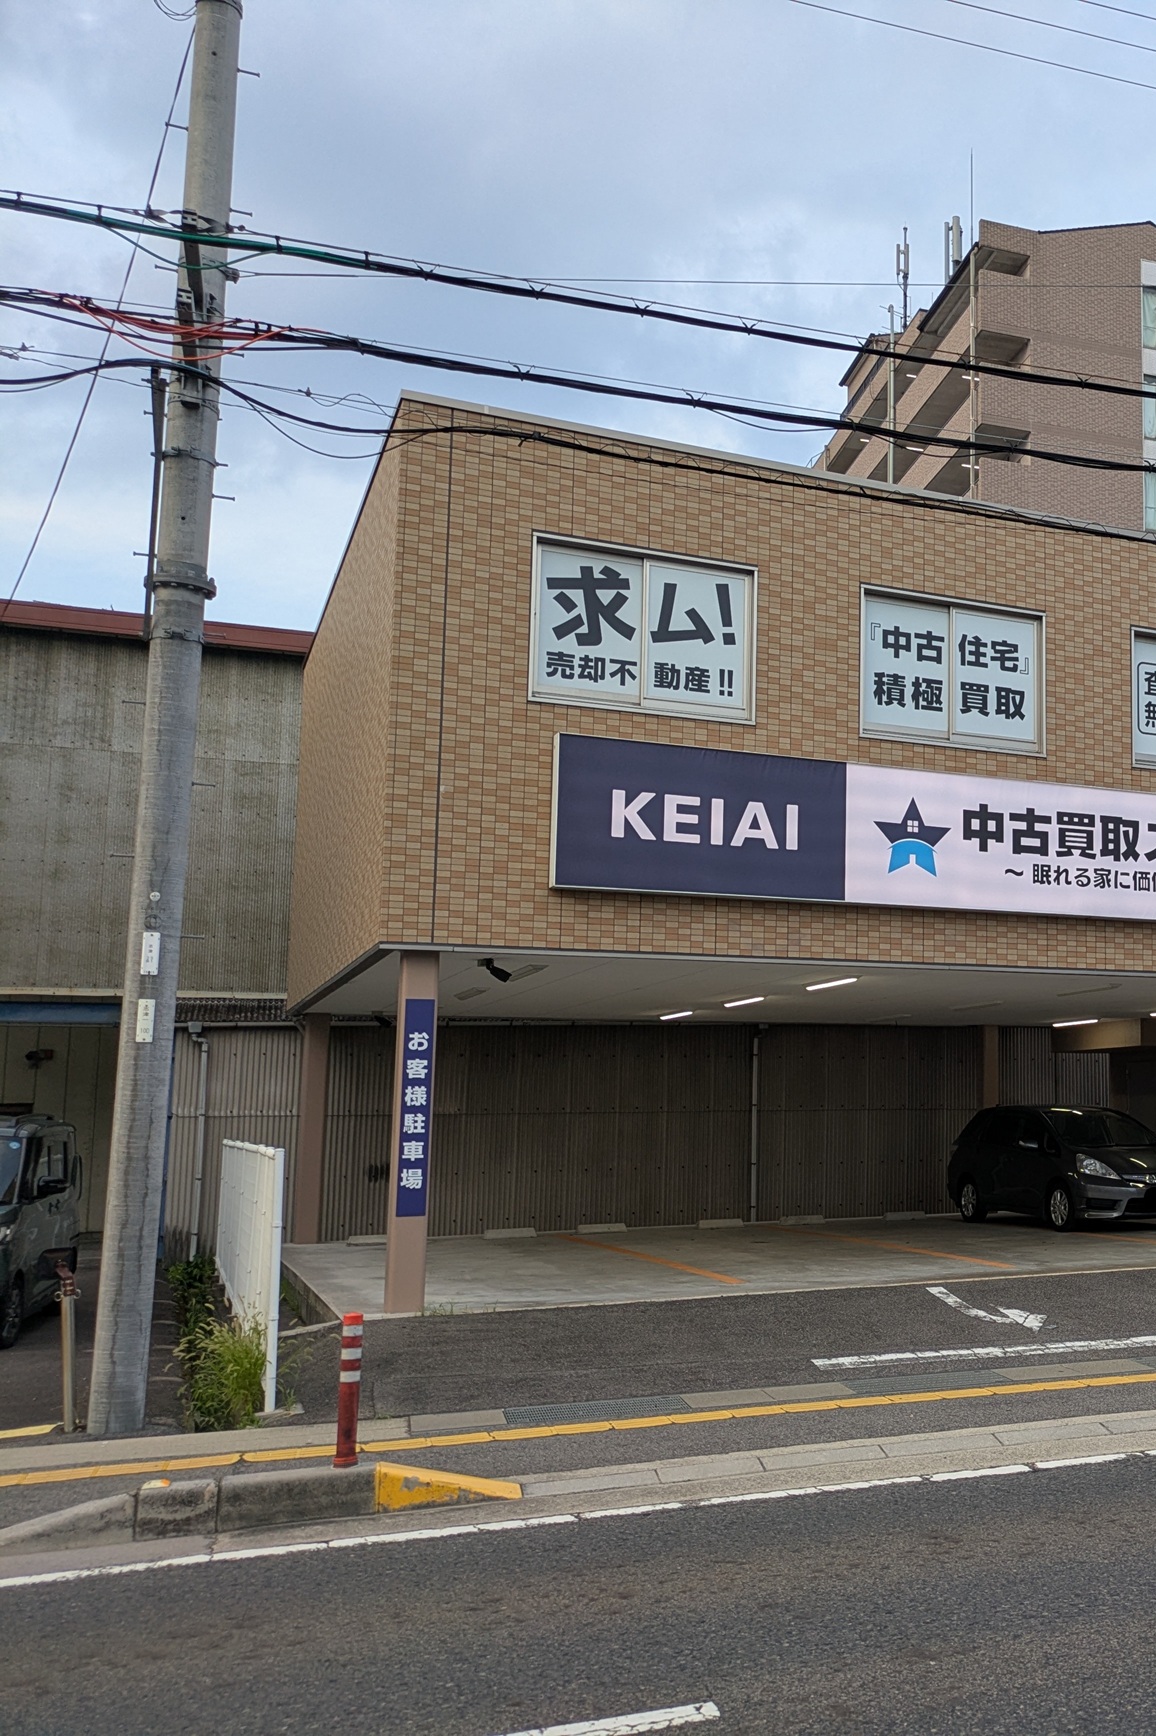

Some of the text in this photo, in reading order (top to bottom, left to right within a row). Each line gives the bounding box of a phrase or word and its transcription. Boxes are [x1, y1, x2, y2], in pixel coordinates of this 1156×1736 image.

[611, 789, 798, 850] KEIAI
[400, 1032, 429, 1190] お客様駐車場
